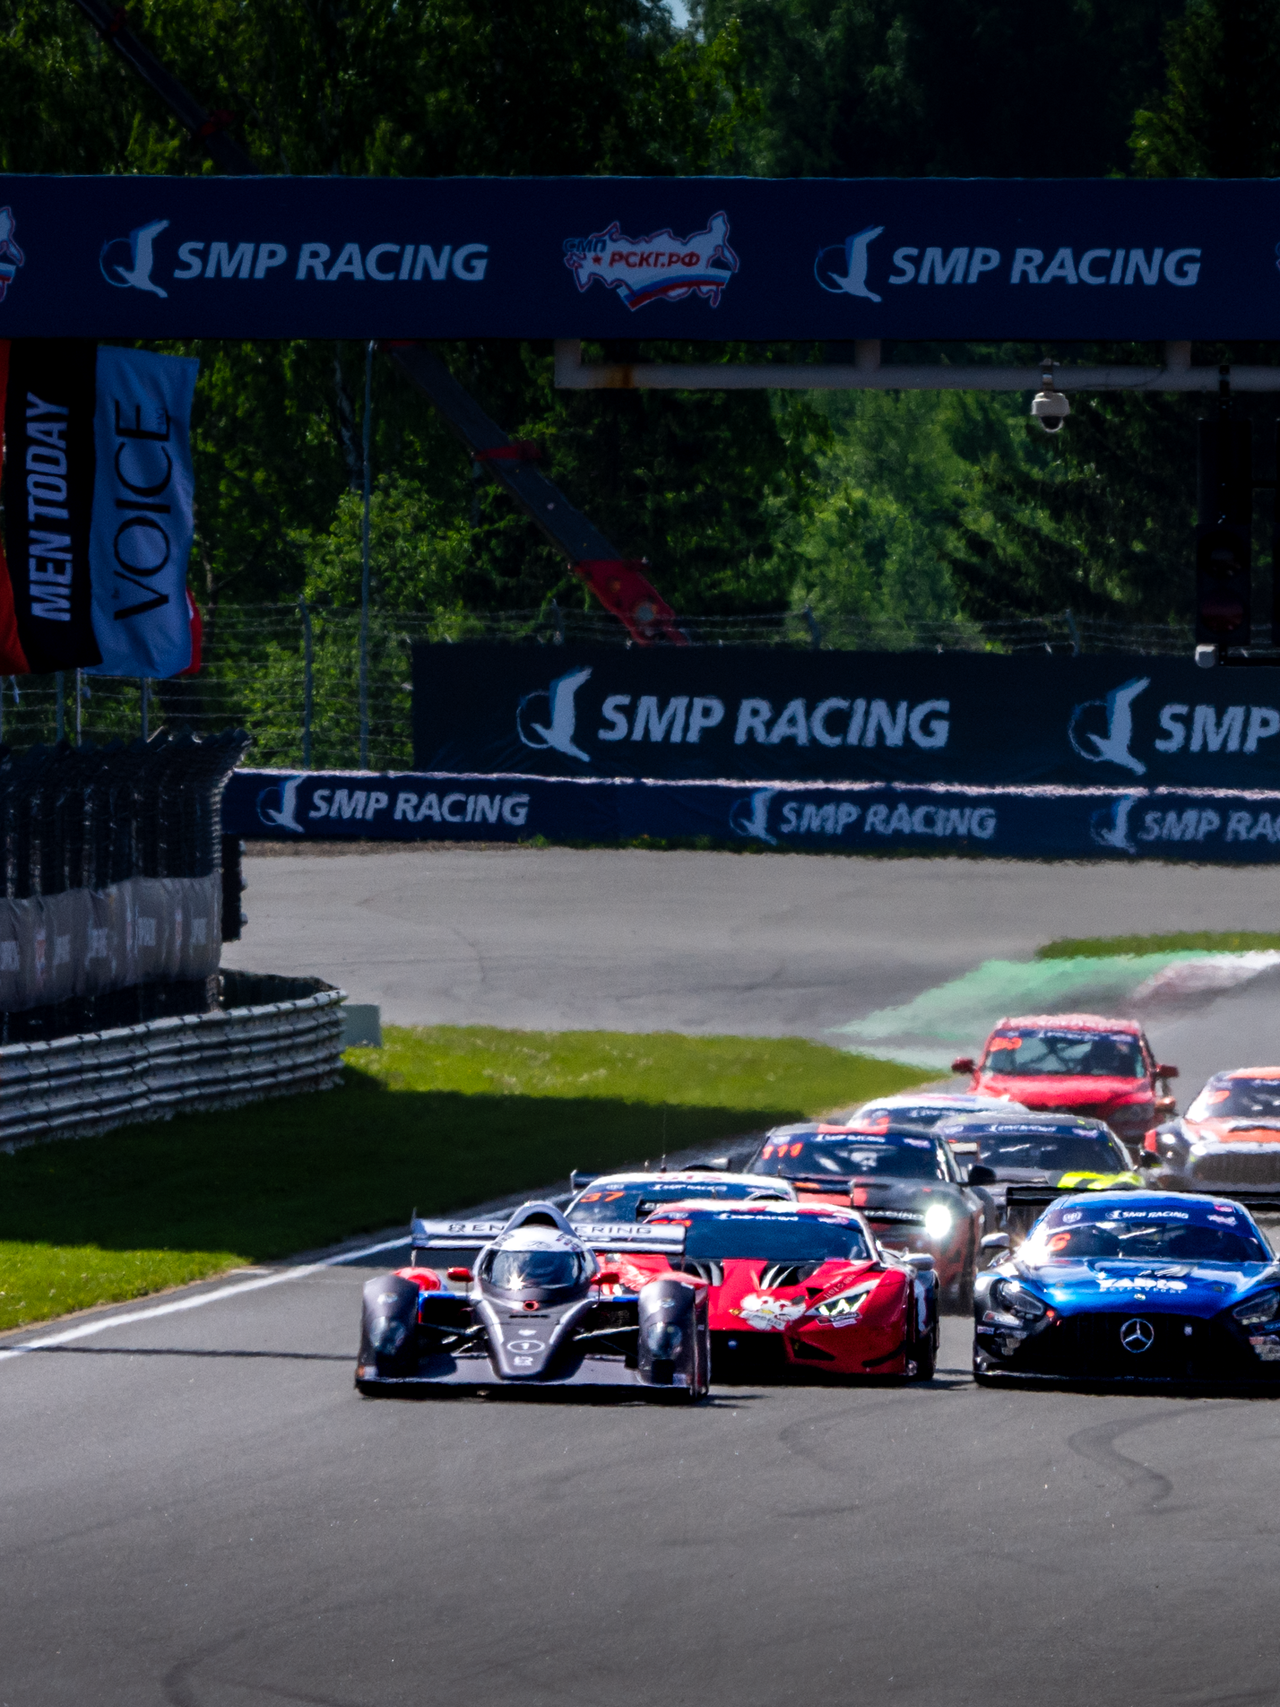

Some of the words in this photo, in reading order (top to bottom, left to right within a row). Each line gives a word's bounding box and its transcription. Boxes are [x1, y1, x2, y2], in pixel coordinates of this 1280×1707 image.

[174, 242, 287, 280] SMP
[296, 242, 488, 281] RACING
[608, 251, 701, 268] РСКГ.РФ
[888, 247, 1000, 285] SMP
[1011, 247, 1202, 287] RACING
[25, 390, 71, 523] TODAY
[113, 400, 173, 620] VOICE
[28, 530, 74, 622] MEN
[598, 695, 725, 743] SMP
[734, 697, 950, 749] RACING
[309, 788, 389, 820] SMP
[393, 792, 530, 826] RACING
[780, 801, 861, 834] SMP
[864, 803, 997, 839] RACING
[1141, 808, 1221, 841] SMP
[761, 1143, 804, 1161] 111
[579, 1191, 625, 1203] 37
[520, 1342, 530, 1351] 1
